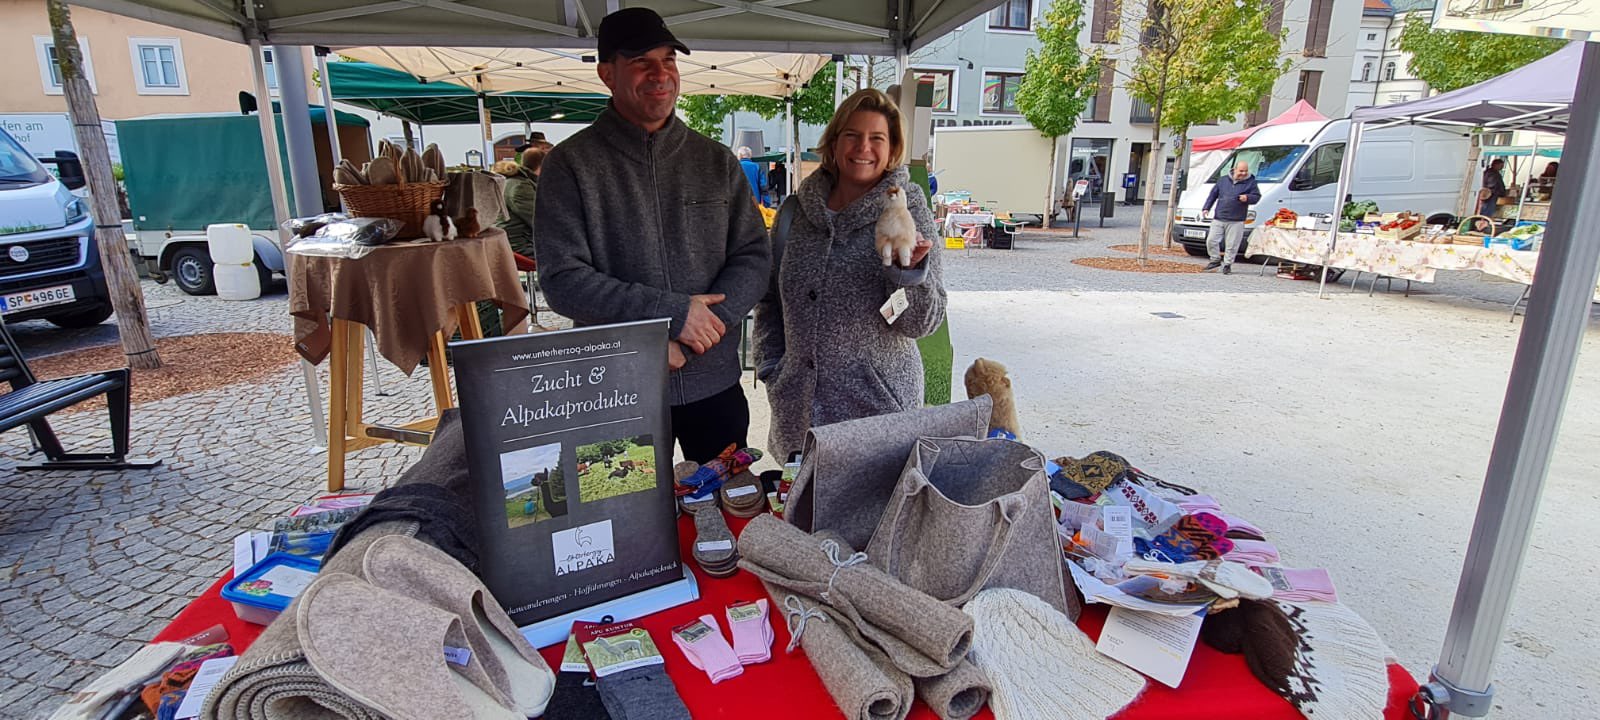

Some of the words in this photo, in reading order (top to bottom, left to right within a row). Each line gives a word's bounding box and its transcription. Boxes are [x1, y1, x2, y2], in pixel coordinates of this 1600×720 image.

[0, 120, 22, 131] fen
[25, 122, 44, 131] am
[15, 133, 31, 142] hof
[512, 341, 621, 361] www.unterherzog-alpaka.at
[531, 370, 582, 394] Zucht
[588, 366, 606, 385] &
[501, 389, 638, 427] Alpakaprodukte
[557, 552, 615, 576] ALPAKA
[628, 561, 678, 582] Alpakapicknick
